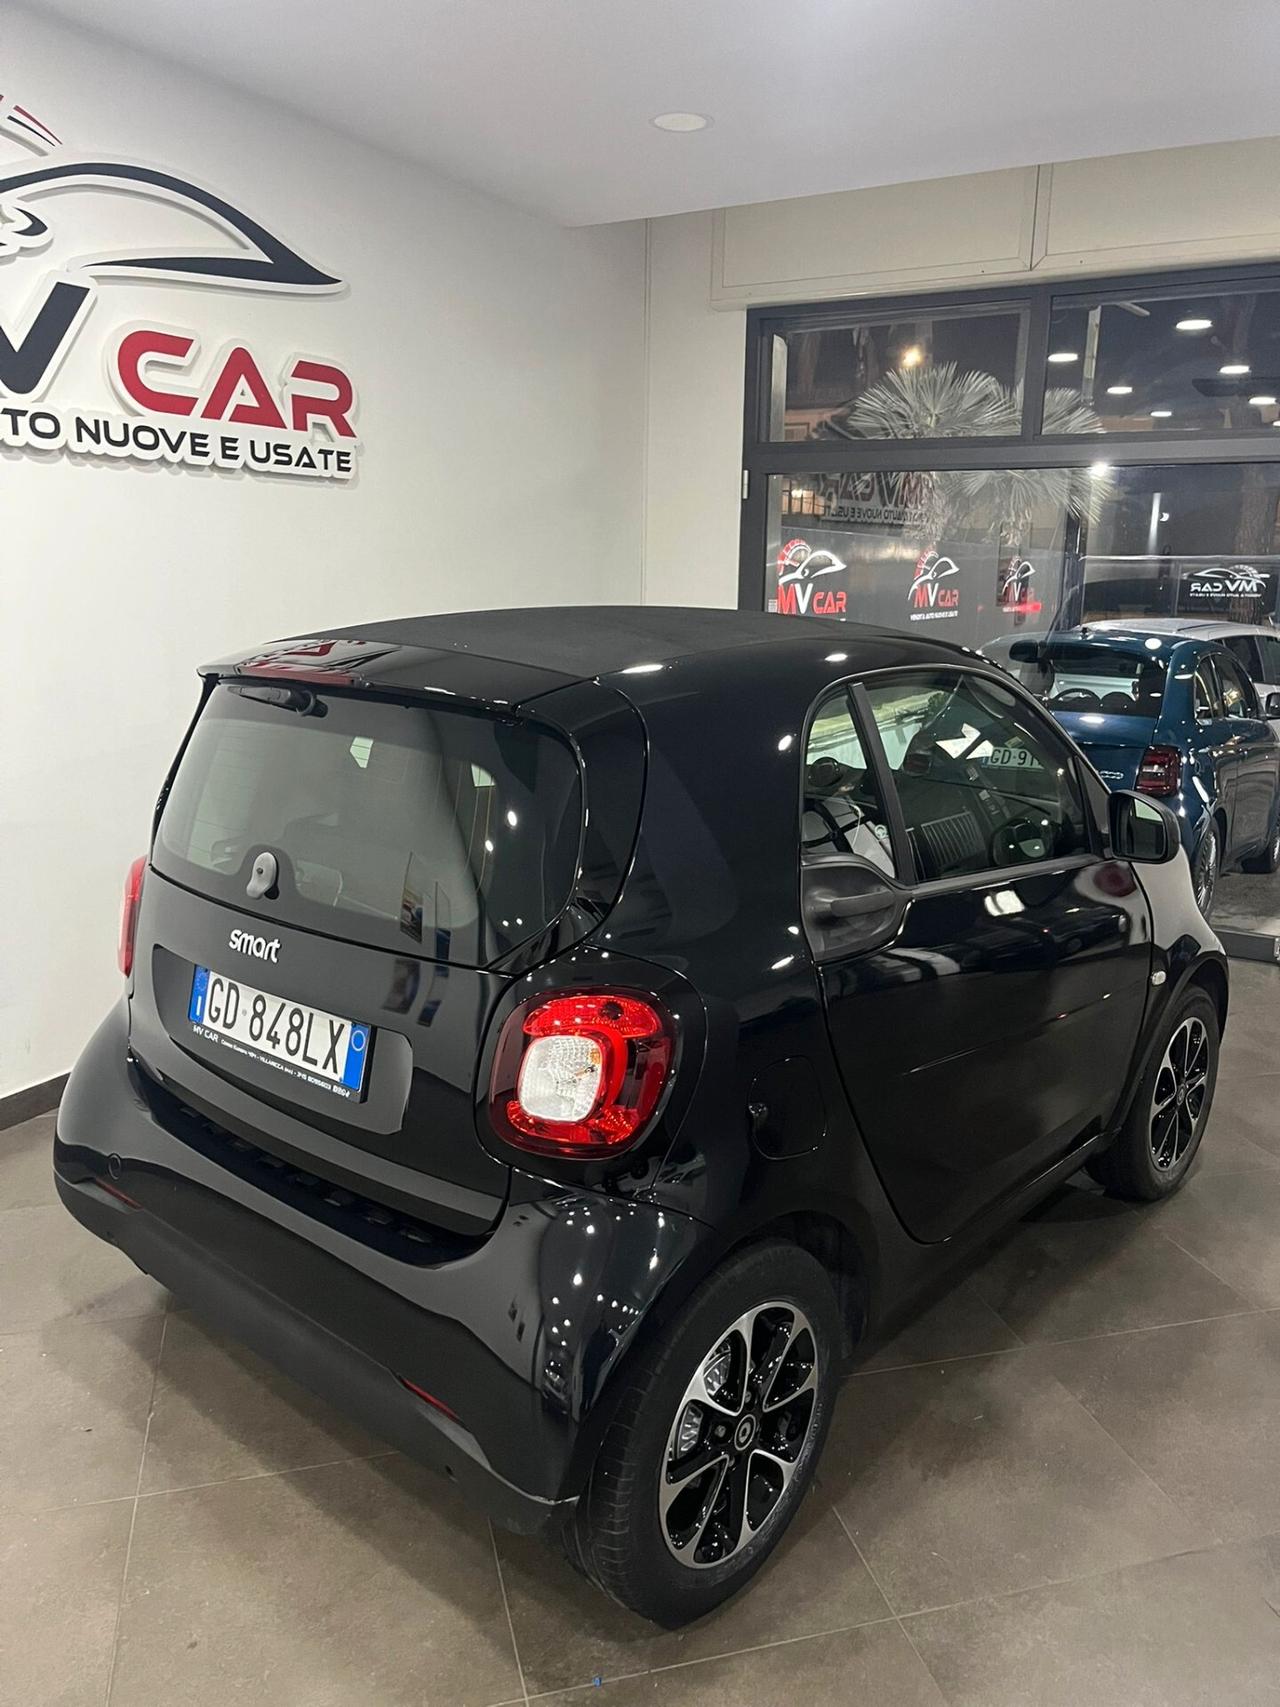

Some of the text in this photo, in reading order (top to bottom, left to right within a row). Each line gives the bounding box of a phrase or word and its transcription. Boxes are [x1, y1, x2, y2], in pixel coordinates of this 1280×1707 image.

[117, 330, 357, 438] CAR
[76, 416, 210, 457] NUOVE
[220, 436, 240, 460] E
[250, 439, 352, 472] USATE
[777, 583, 814, 614] MV
[813, 591, 847, 614] CAR
[913, 582, 959, 608] MV CAR
[991, 749, 1011, 764] GD
[229, 928, 281, 963] smart
[204, 1029, 219, 1043] CAR
[208, 978, 240, 1030] GD
[249, 994, 345, 1074] 848LX
